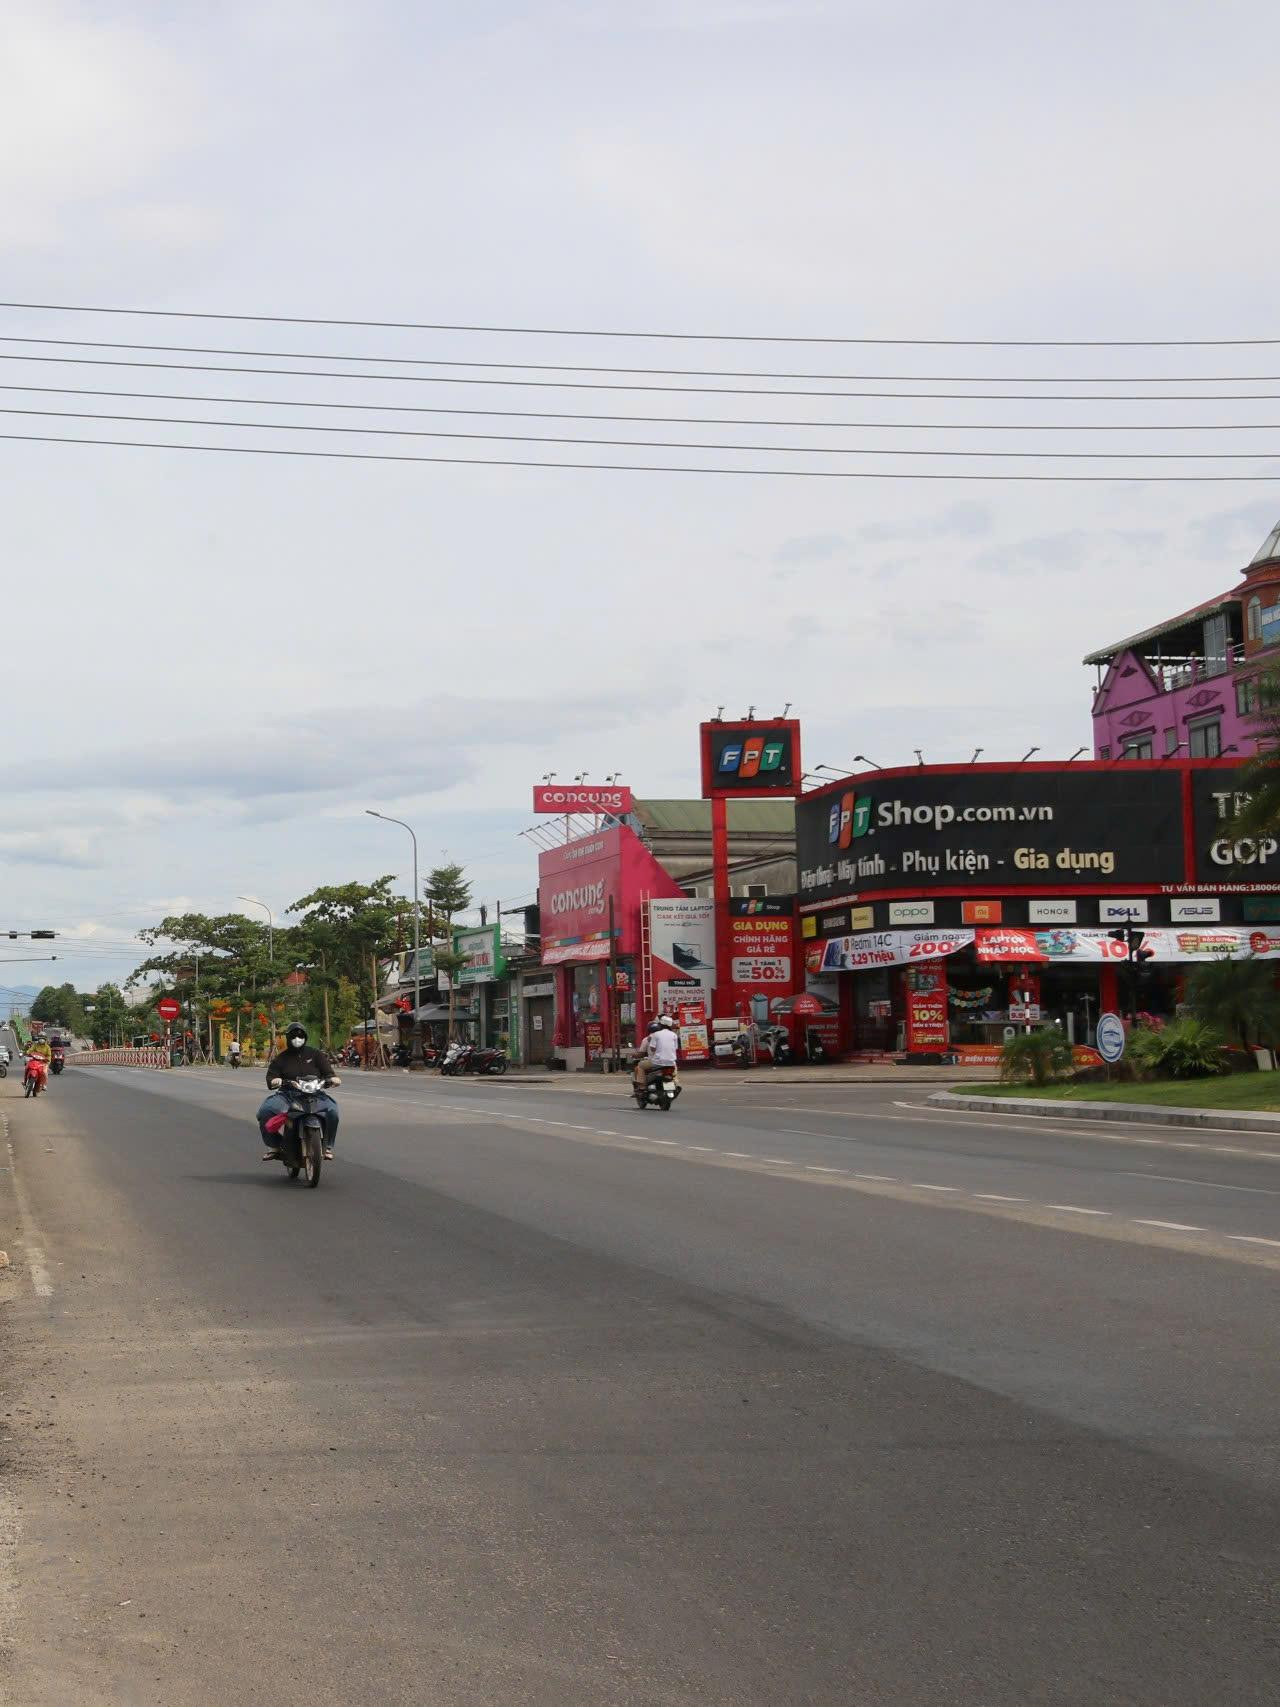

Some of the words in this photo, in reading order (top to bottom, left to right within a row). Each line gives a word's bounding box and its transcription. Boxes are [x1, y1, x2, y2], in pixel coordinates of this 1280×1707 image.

[878, 800, 1054, 831] Shop.com.vn
[858, 853, 886, 877] tính
[902, 849, 940, 876] Phụ
[945, 848, 989, 875] kiện
[1014, 847, 1049, 869] Gia
[1055, 847, 1115, 875] dụng
[1107, 907, 1140, 917] DELL
[1178, 907, 1214, 916] ASUS
[733, 921, 754, 931] GIA
[756, 921, 789, 932] DỤNG
[733, 934, 762, 943] CHÍNH
[874, 934, 892, 948] 14C
[983, 936, 1026, 945] LAPTOP
[746, 944, 762, 953] GIÁ
[978, 945, 1009, 956] NHẬP
[1011, 945, 1036, 956] HỌC
[869, 949, 896, 965] Triệu
[913, 1009, 945, 1021] 10%
